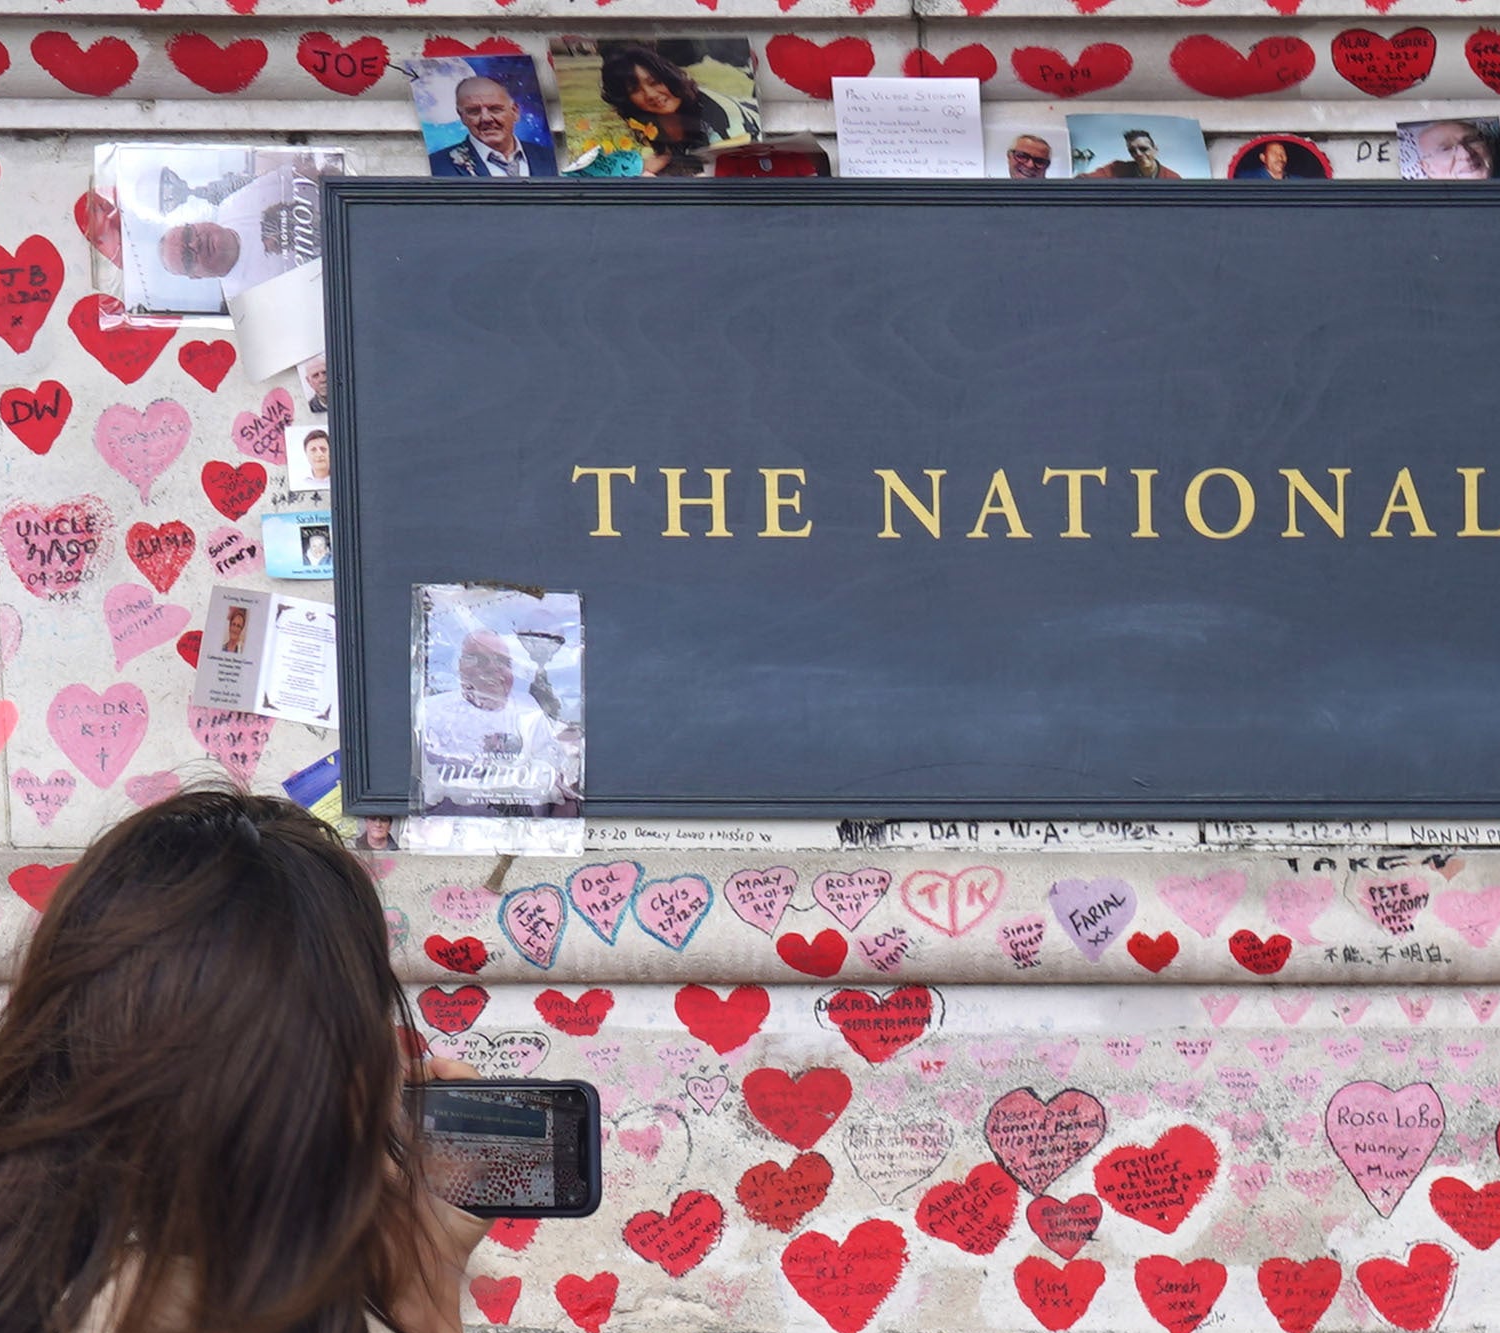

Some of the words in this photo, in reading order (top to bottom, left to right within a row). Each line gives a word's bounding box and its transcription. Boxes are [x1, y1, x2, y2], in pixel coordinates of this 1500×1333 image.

[311, 49, 378, 78] JOE
[9, 389, 61, 425] DW
[573, 466, 811, 537] THE
[15, 519, 94, 539] UNCLE
[208, 534, 238, 558] Sarah
[1410, 826, 1479, 842] NANNY
[580, 870, 618, 891] Dad
[735, 873, 781, 889] MARY
[825, 875, 886, 891] ROSINA
[651, 889, 689, 910] Chris
[1368, 884, 1409, 899] PETE
[1068, 894, 1127, 936] FARIAL
[1338, 1109, 1388, 1125] Rosa
